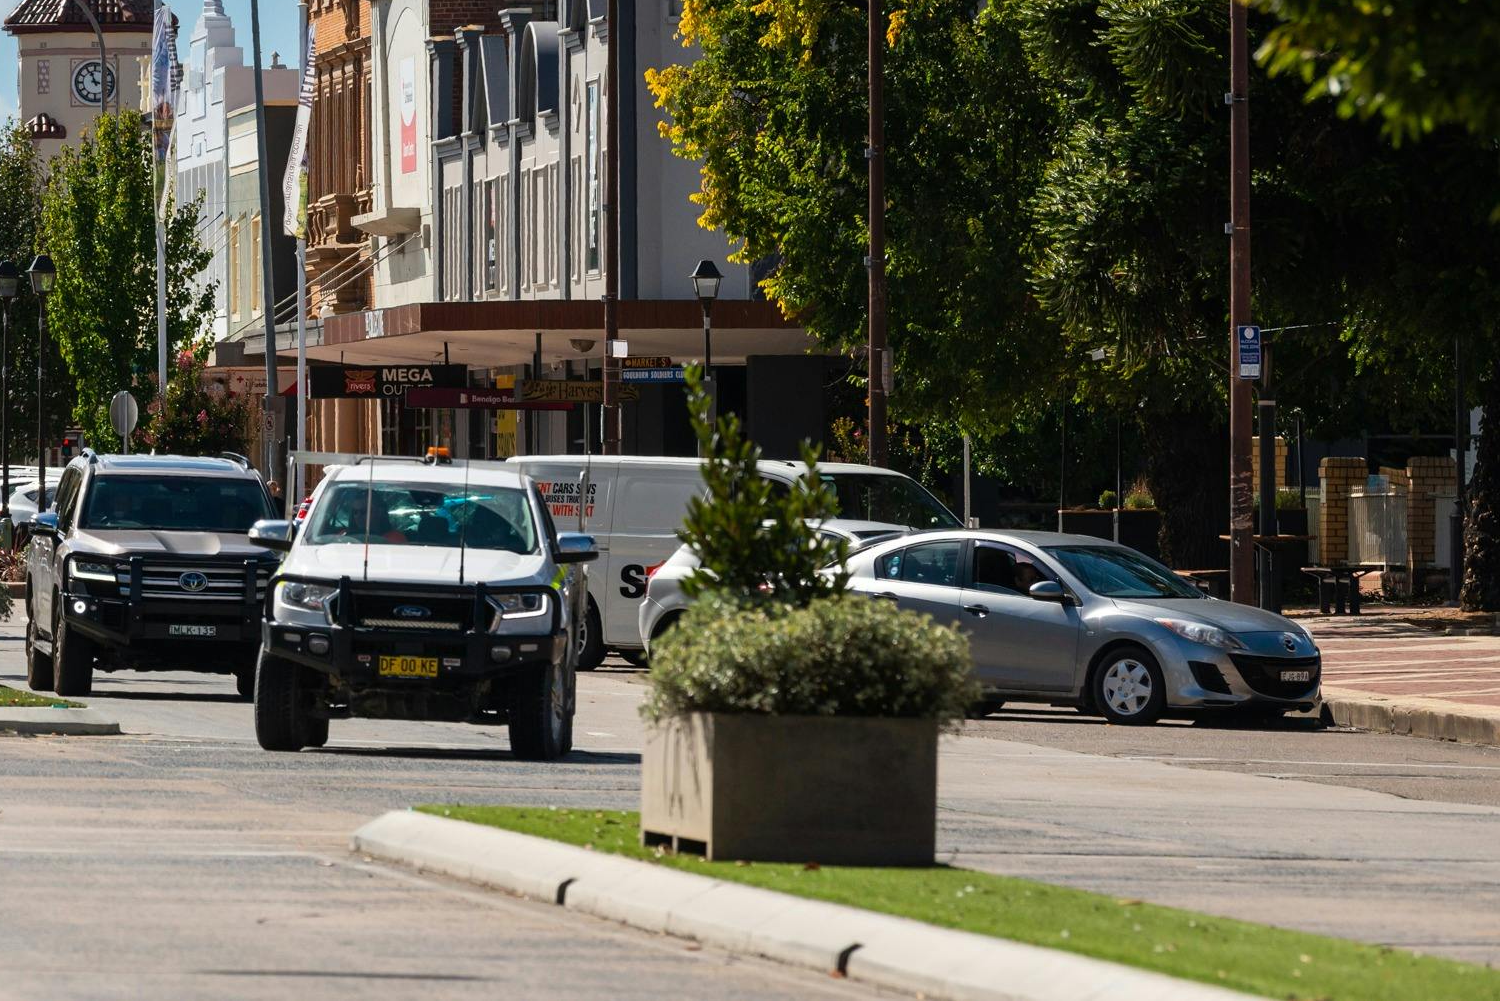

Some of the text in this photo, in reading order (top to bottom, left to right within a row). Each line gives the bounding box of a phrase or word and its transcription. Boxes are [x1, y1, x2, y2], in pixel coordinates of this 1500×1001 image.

[631, 357, 657, 367] MARKET
[382, 368, 433, 382] MEGA
[650, 370, 674, 379] SOLDIERS
[350, 382, 373, 391] rivers
[472, 395, 501, 405] Bendigo
[552, 482, 574, 494] CARS
[575, 483, 597, 495] SVS
[589, 496, 595, 504] &
[552, 504, 573, 516] WITH
[380, 658, 397, 672] DF
[420, 659, 437, 674] KE
